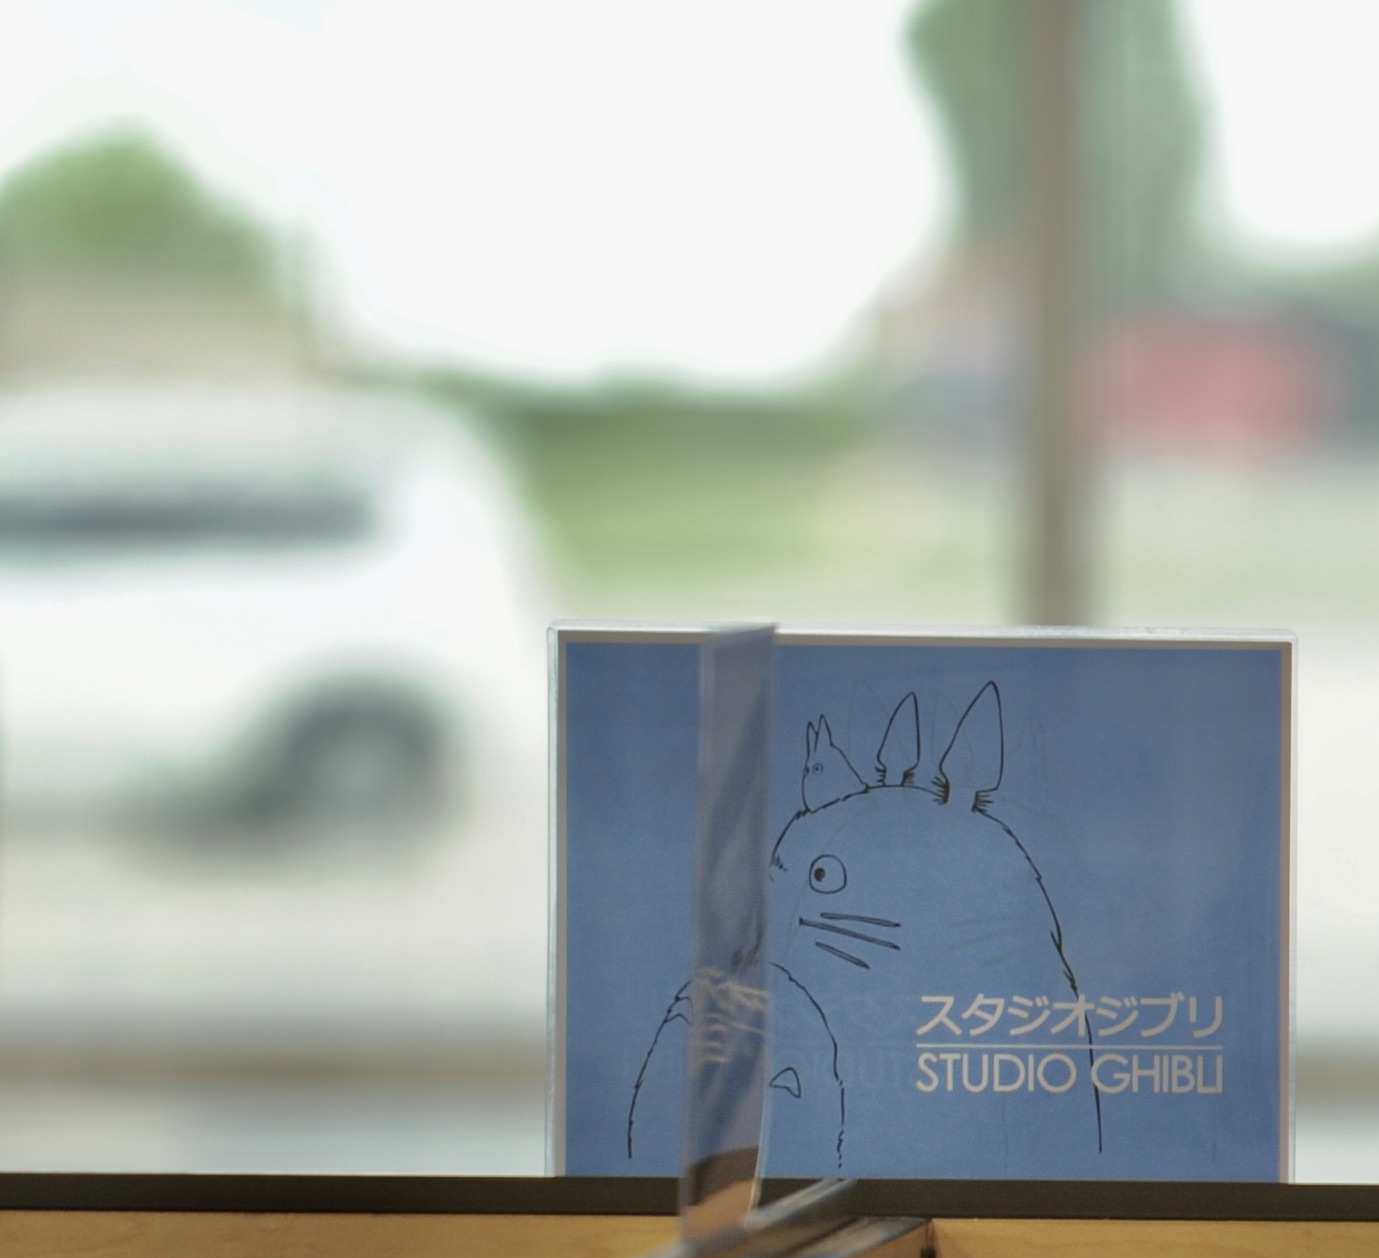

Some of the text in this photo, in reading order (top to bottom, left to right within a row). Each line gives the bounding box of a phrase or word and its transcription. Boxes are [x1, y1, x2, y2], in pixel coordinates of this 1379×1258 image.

[916, 991, 1223, 1038] スタジオジブリ
[916, 1052, 1223, 1094] STUDIO GHIBLI
